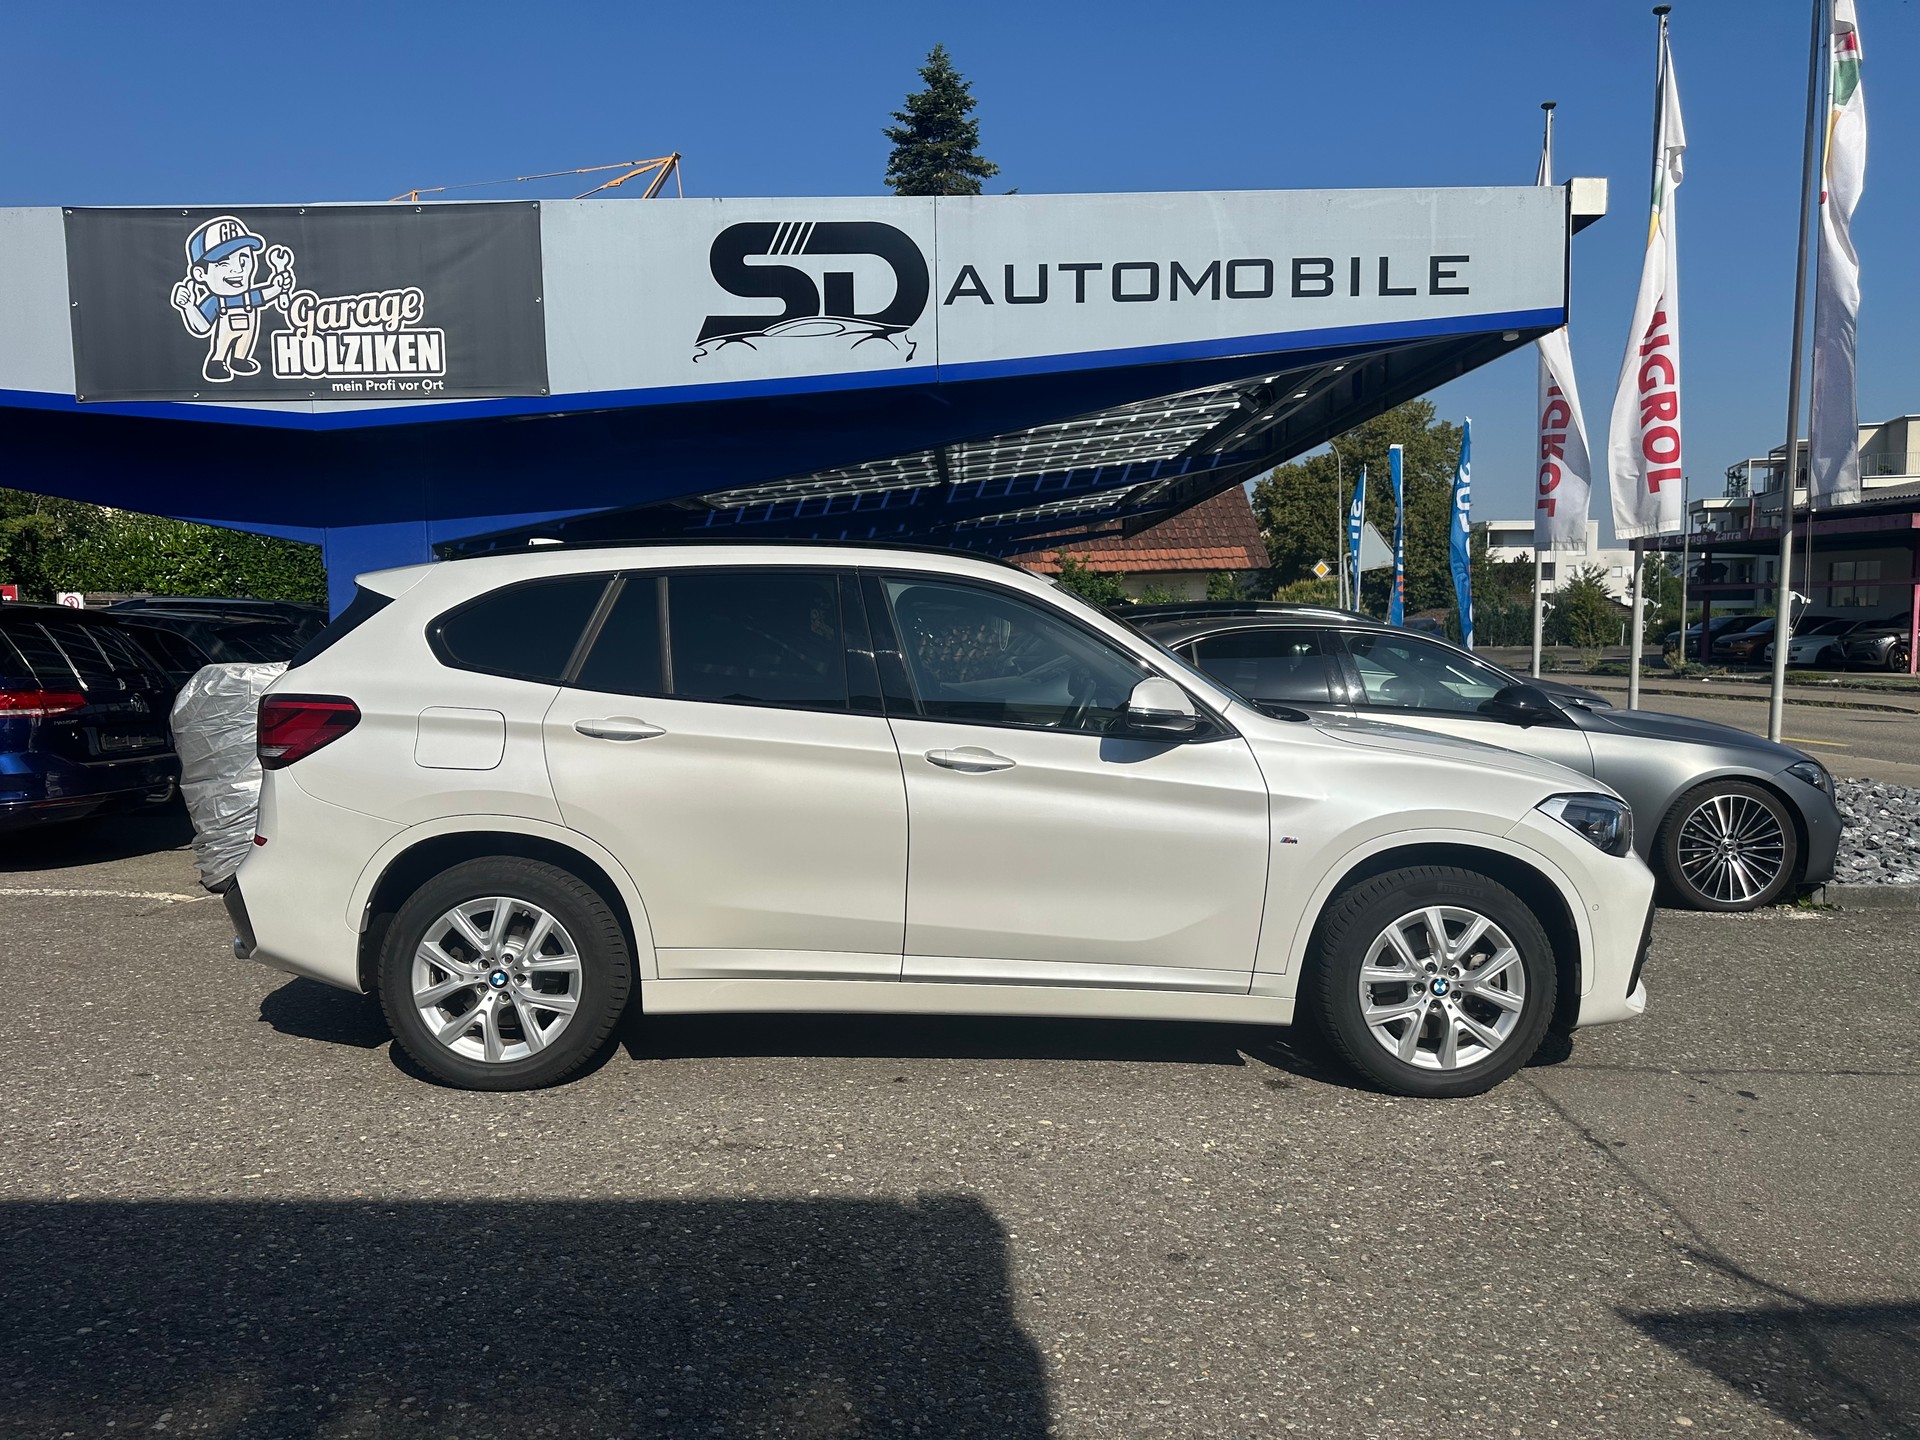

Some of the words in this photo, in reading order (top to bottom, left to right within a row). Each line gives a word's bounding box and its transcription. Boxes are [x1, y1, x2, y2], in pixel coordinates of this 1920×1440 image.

[219, 222, 239, 243] GB
[694, 221, 930, 347] SD
[943, 254, 1471, 306] AUTOMOBILE
[290, 292, 419, 341] Garage
[276, 333, 441, 374] HOLZIKEN
[331, 380, 363, 393] mein
[365, 379, 396, 392] Profi
[398, 382, 420, 391] vor
[421, 378, 444, 391] Ort
[1714, 530, 1742, 541] Zarra
